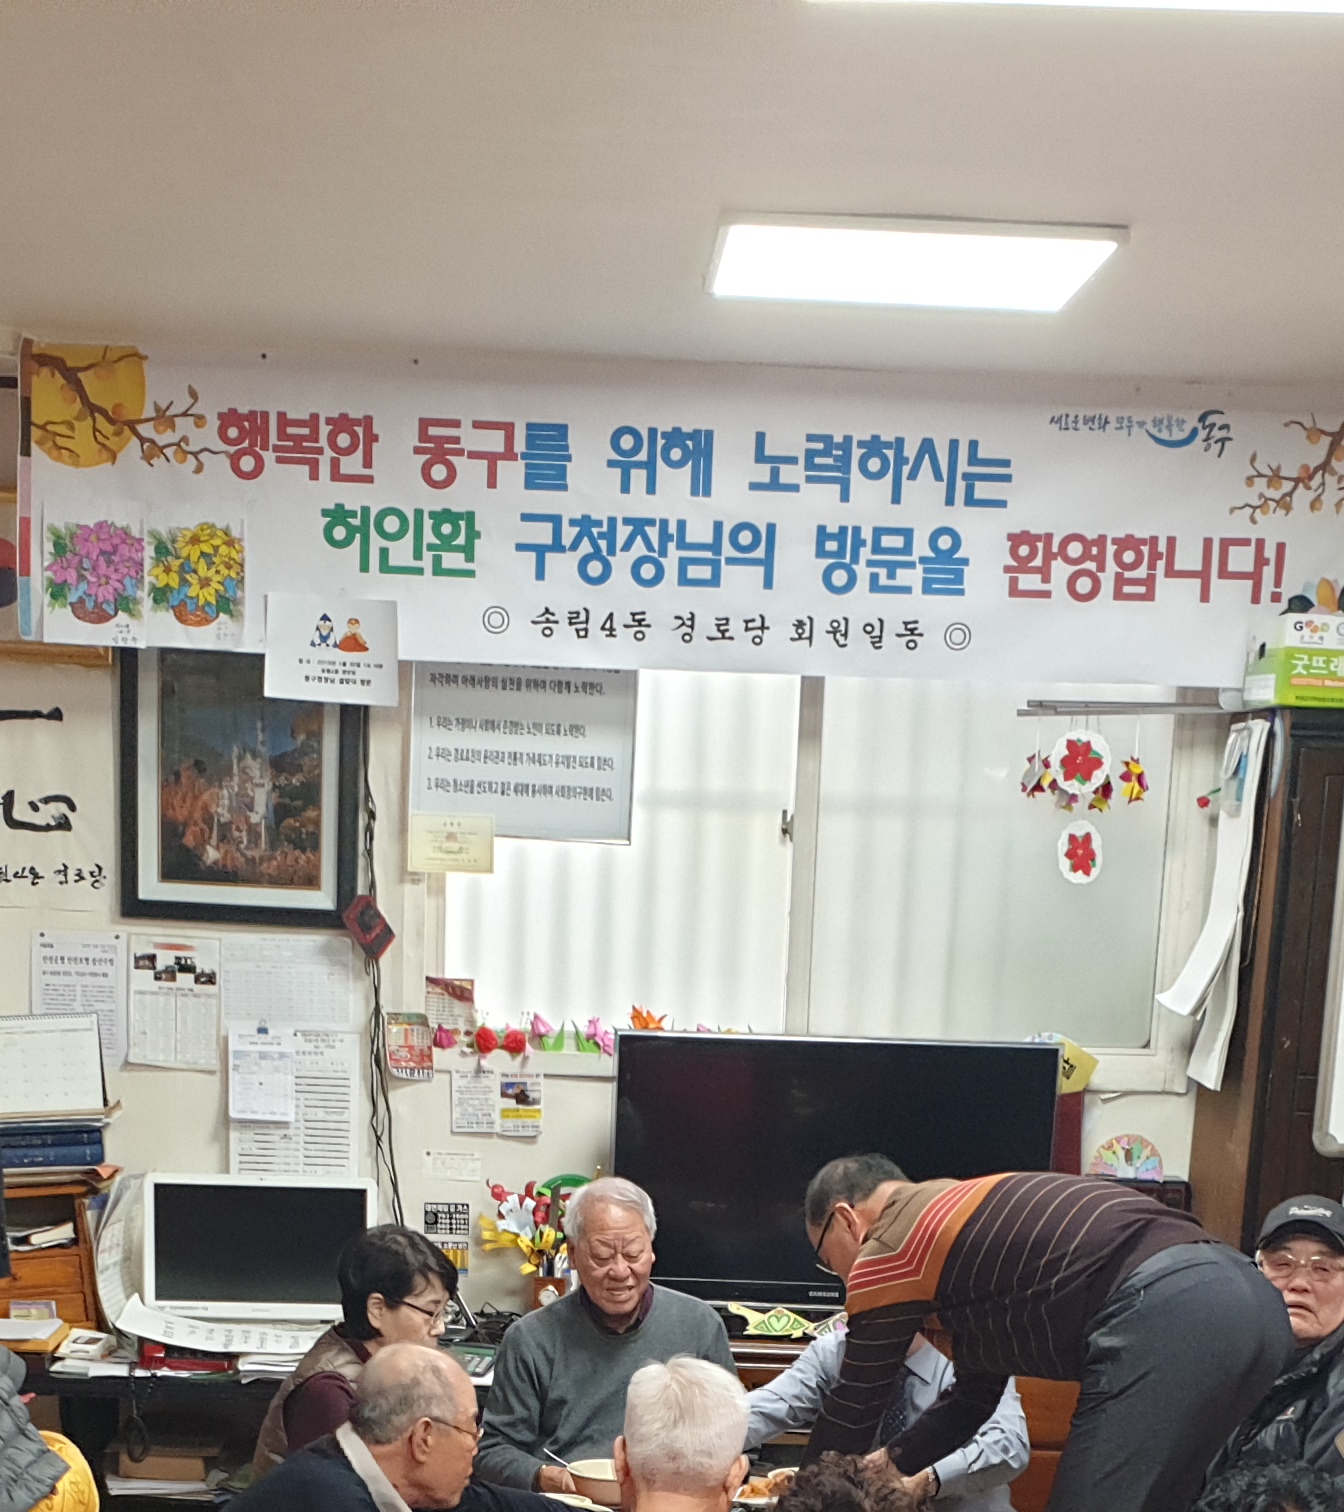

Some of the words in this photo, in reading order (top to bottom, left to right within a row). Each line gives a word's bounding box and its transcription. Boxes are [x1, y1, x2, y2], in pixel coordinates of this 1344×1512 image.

[217, 408, 379, 484] 행복한
[413, 417, 572, 491] 동구를
[607, 425, 713, 497] 위해
[748, 432, 1012, 508] 노력하시는
[1198, 409, 1233, 459] 동구
[321, 503, 481, 578] 허인환
[515, 512, 776, 590] 구청장님의
[815, 525, 970, 596] 방문을
[1003, 529, 1286, 605] 환영합니다!
[531, 607, 652, 643] 송림4동
[671, 612, 771, 646] 경로당
